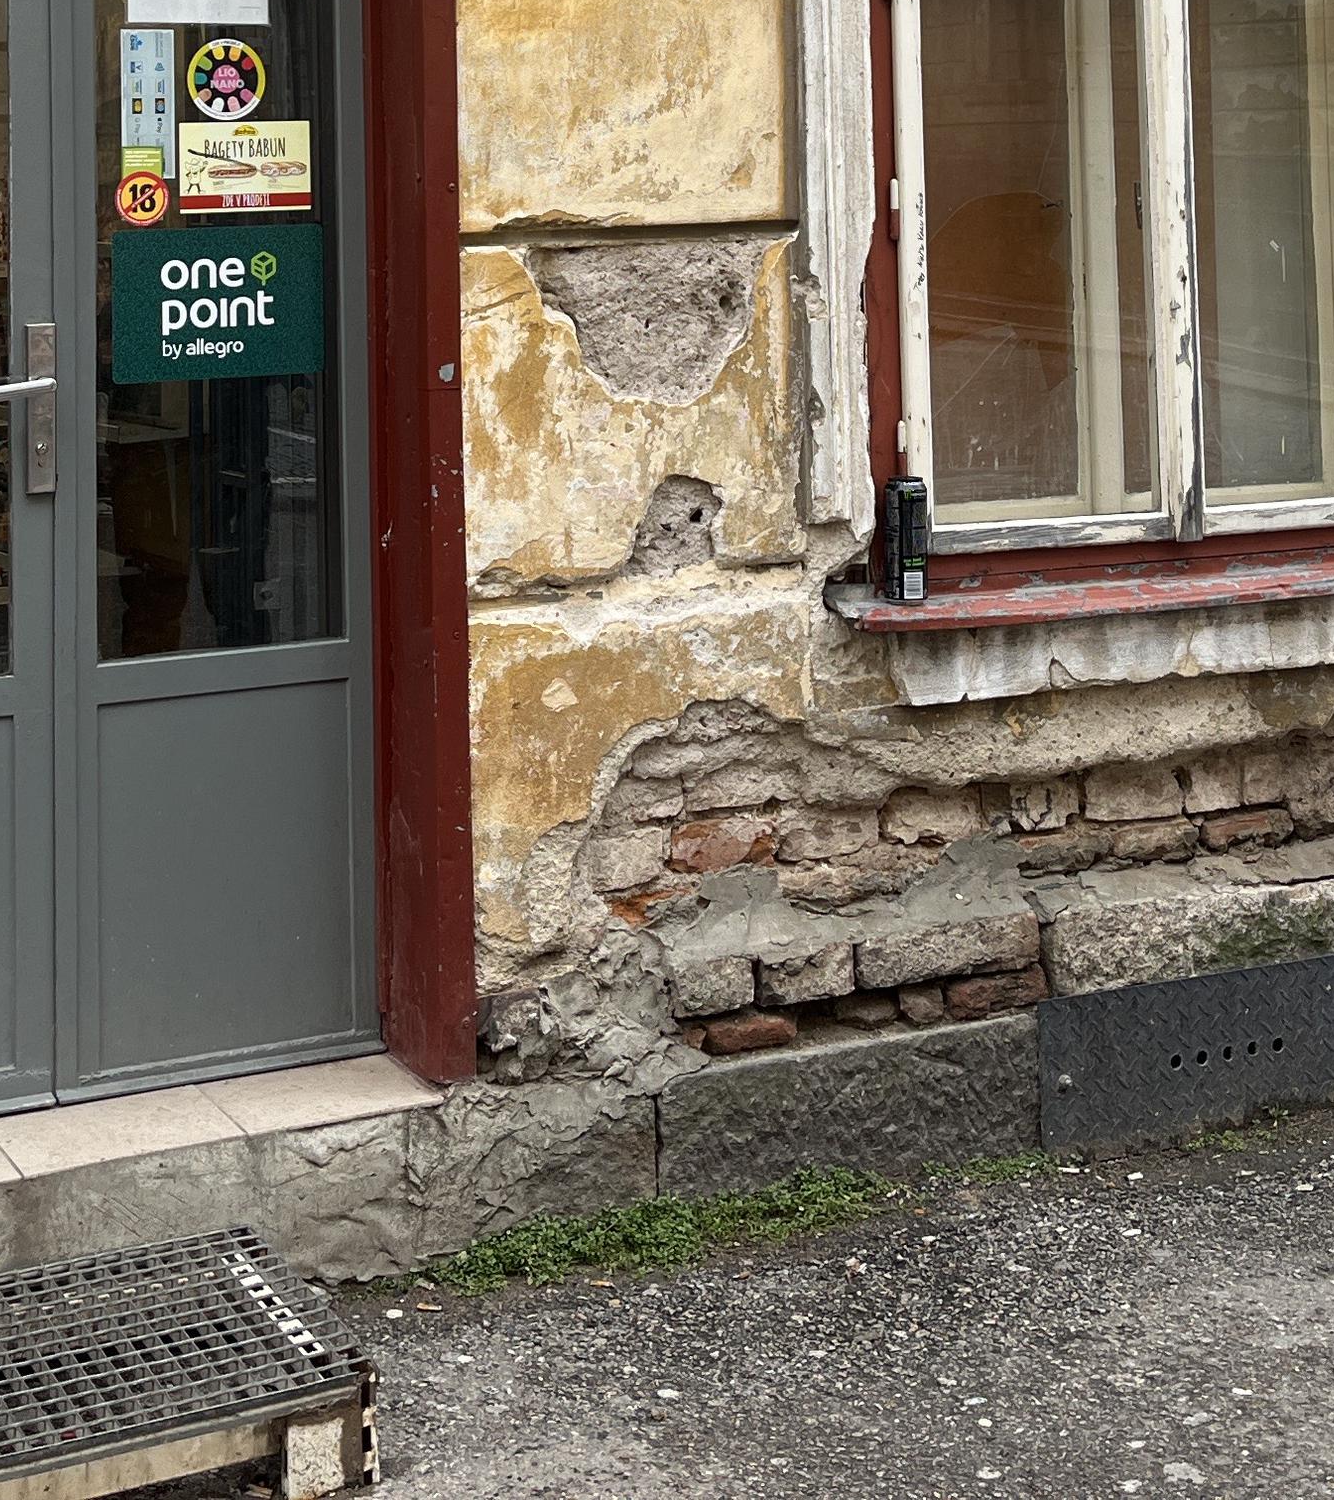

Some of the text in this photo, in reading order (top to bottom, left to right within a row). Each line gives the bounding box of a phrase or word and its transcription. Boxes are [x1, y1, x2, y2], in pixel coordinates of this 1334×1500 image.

[218, 67, 236, 77] LIO
[210, 79, 245, 89] NANO
[204, 137, 286, 159] BAGETY BABUN
[129, 183, 156, 213] 18
[160, 257, 245, 290] one
[161, 290, 275, 336] point
[162, 338, 245, 360] by allegro
